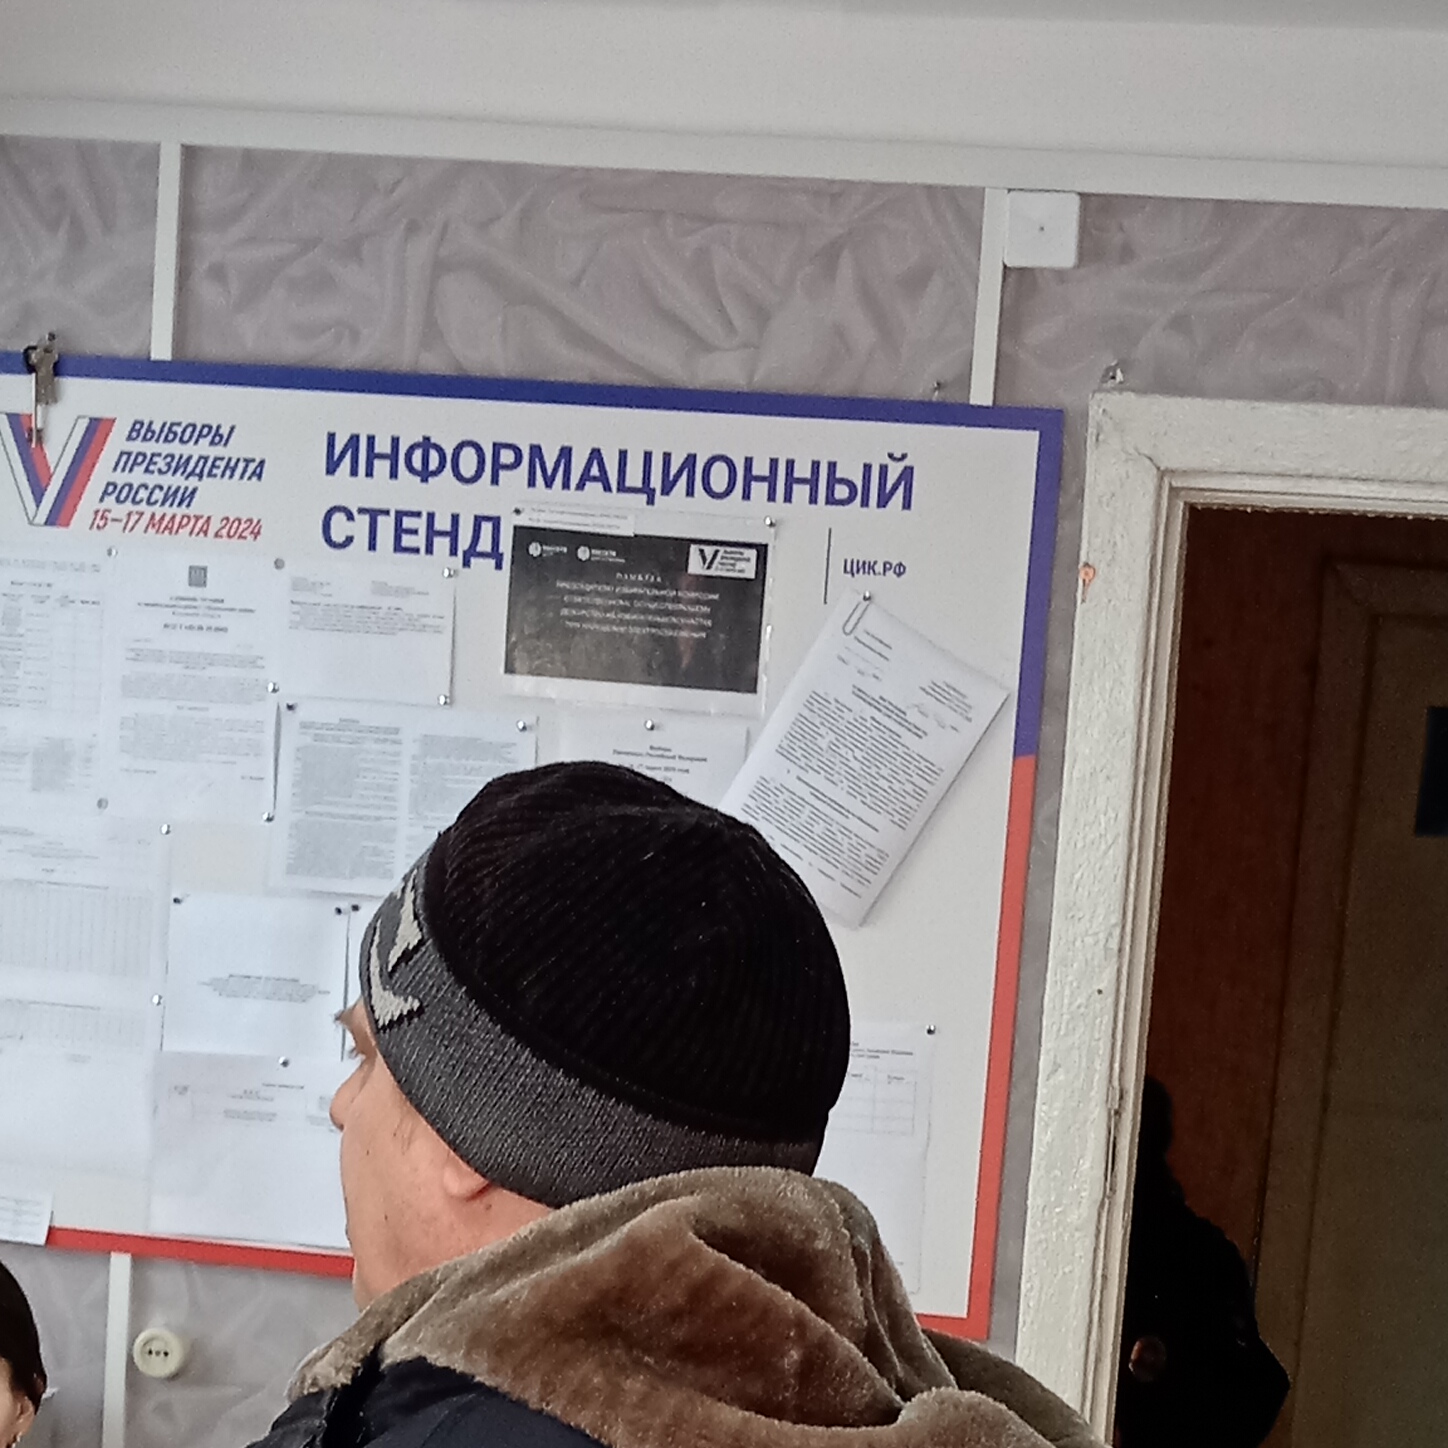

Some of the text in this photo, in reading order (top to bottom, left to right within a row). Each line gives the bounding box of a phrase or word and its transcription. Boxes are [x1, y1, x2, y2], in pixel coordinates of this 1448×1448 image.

[126, 419, 236, 448] ВЫБОРЫ
[112, 451, 267, 482] ПРЕЗИДЕНТА
[323, 431, 916, 511] ИНФОРМАЦИОННЫЙ
[99, 482, 199, 509] РОССИИ
[143, 511, 212, 538] МАРТА
[213, 517, 263, 542] 2024
[321, 504, 506, 571] СТЕНД
[843, 557, 907, 579] ЦИК.РФ
